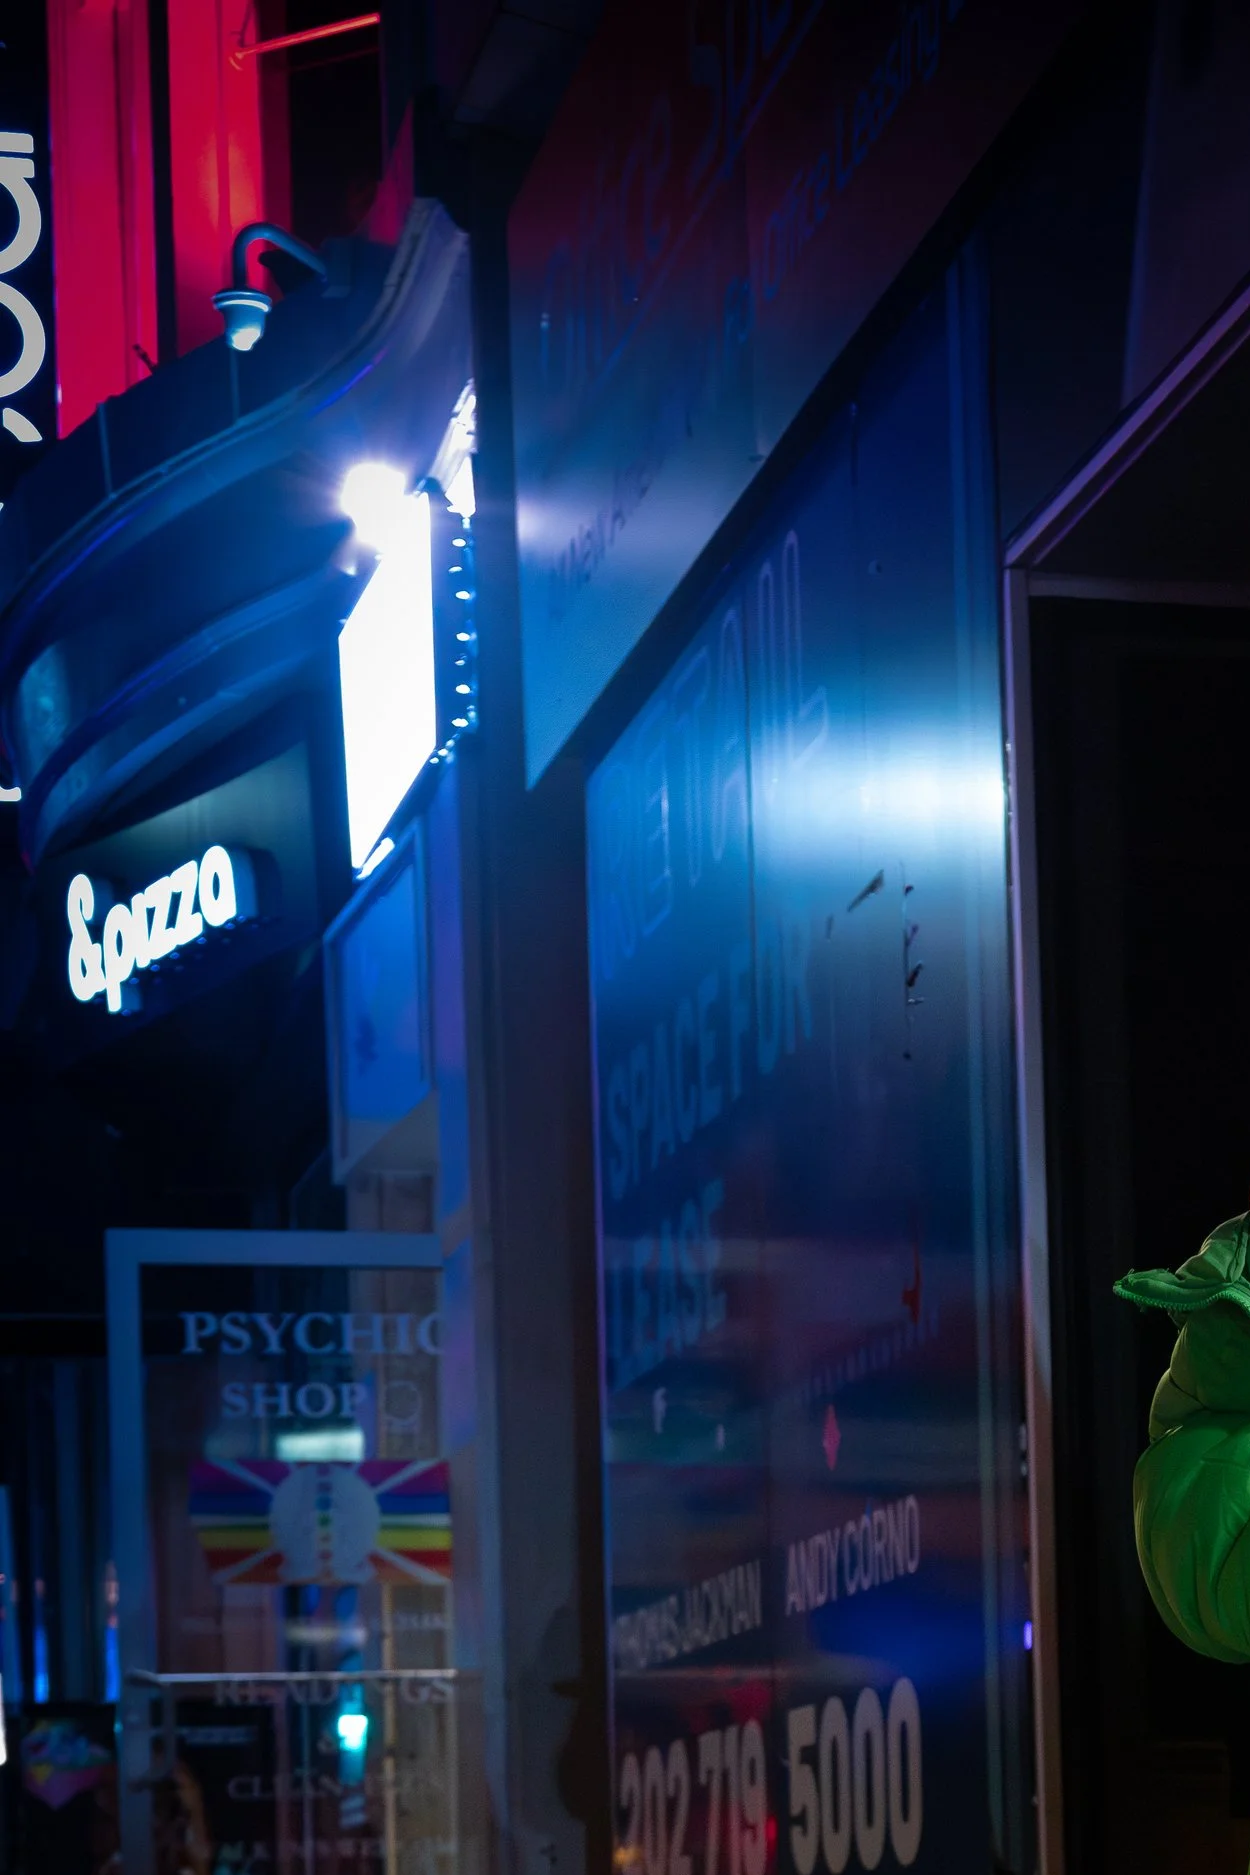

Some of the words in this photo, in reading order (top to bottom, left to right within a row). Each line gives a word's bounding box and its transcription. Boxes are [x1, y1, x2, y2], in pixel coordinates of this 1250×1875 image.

[67, 844, 238, 1014] &pizza
[607, 972, 722, 1200] SPACE
[177, 1310, 444, 1356] PSYCHIC
[609, 1177, 728, 1391] LEASE
[220, 1381, 368, 1419] SHOP
[785, 1525, 840, 1617] ANDY
[842, 1494, 920, 1598] CORNO
